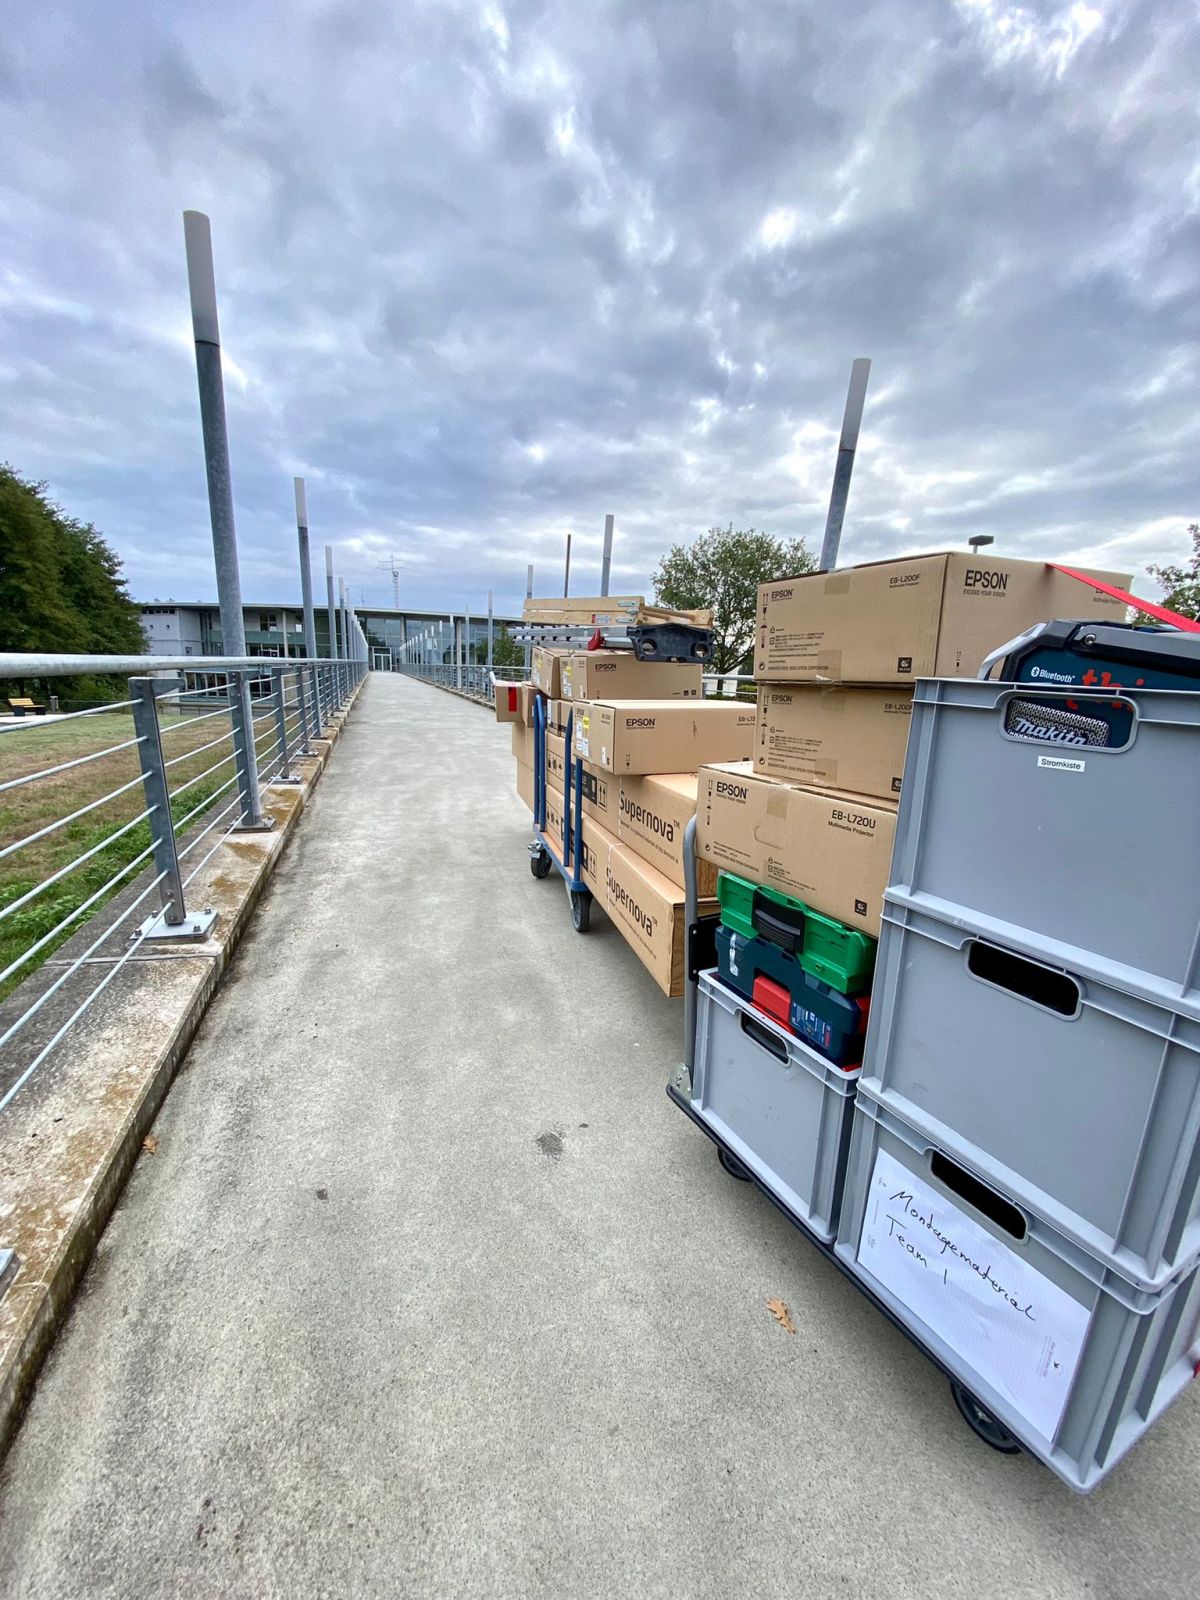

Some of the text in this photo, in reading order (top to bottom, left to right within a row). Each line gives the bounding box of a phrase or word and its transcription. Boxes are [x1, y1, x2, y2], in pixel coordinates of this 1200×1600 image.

[965, 569, 1008, 590] EPSON
[771, 589, 793, 599] EPSON
[1039, 669, 1073, 683] Bluetooth
[772, 694, 793, 703] EPSON
[626, 718, 656, 727] EPSON
[1041, 758, 1081, 770] Stromkiste
[717, 782, 747, 799] EPSON
[832, 809, 876, 829] EB-L720U
[886, 1214, 927, 1268] Team
